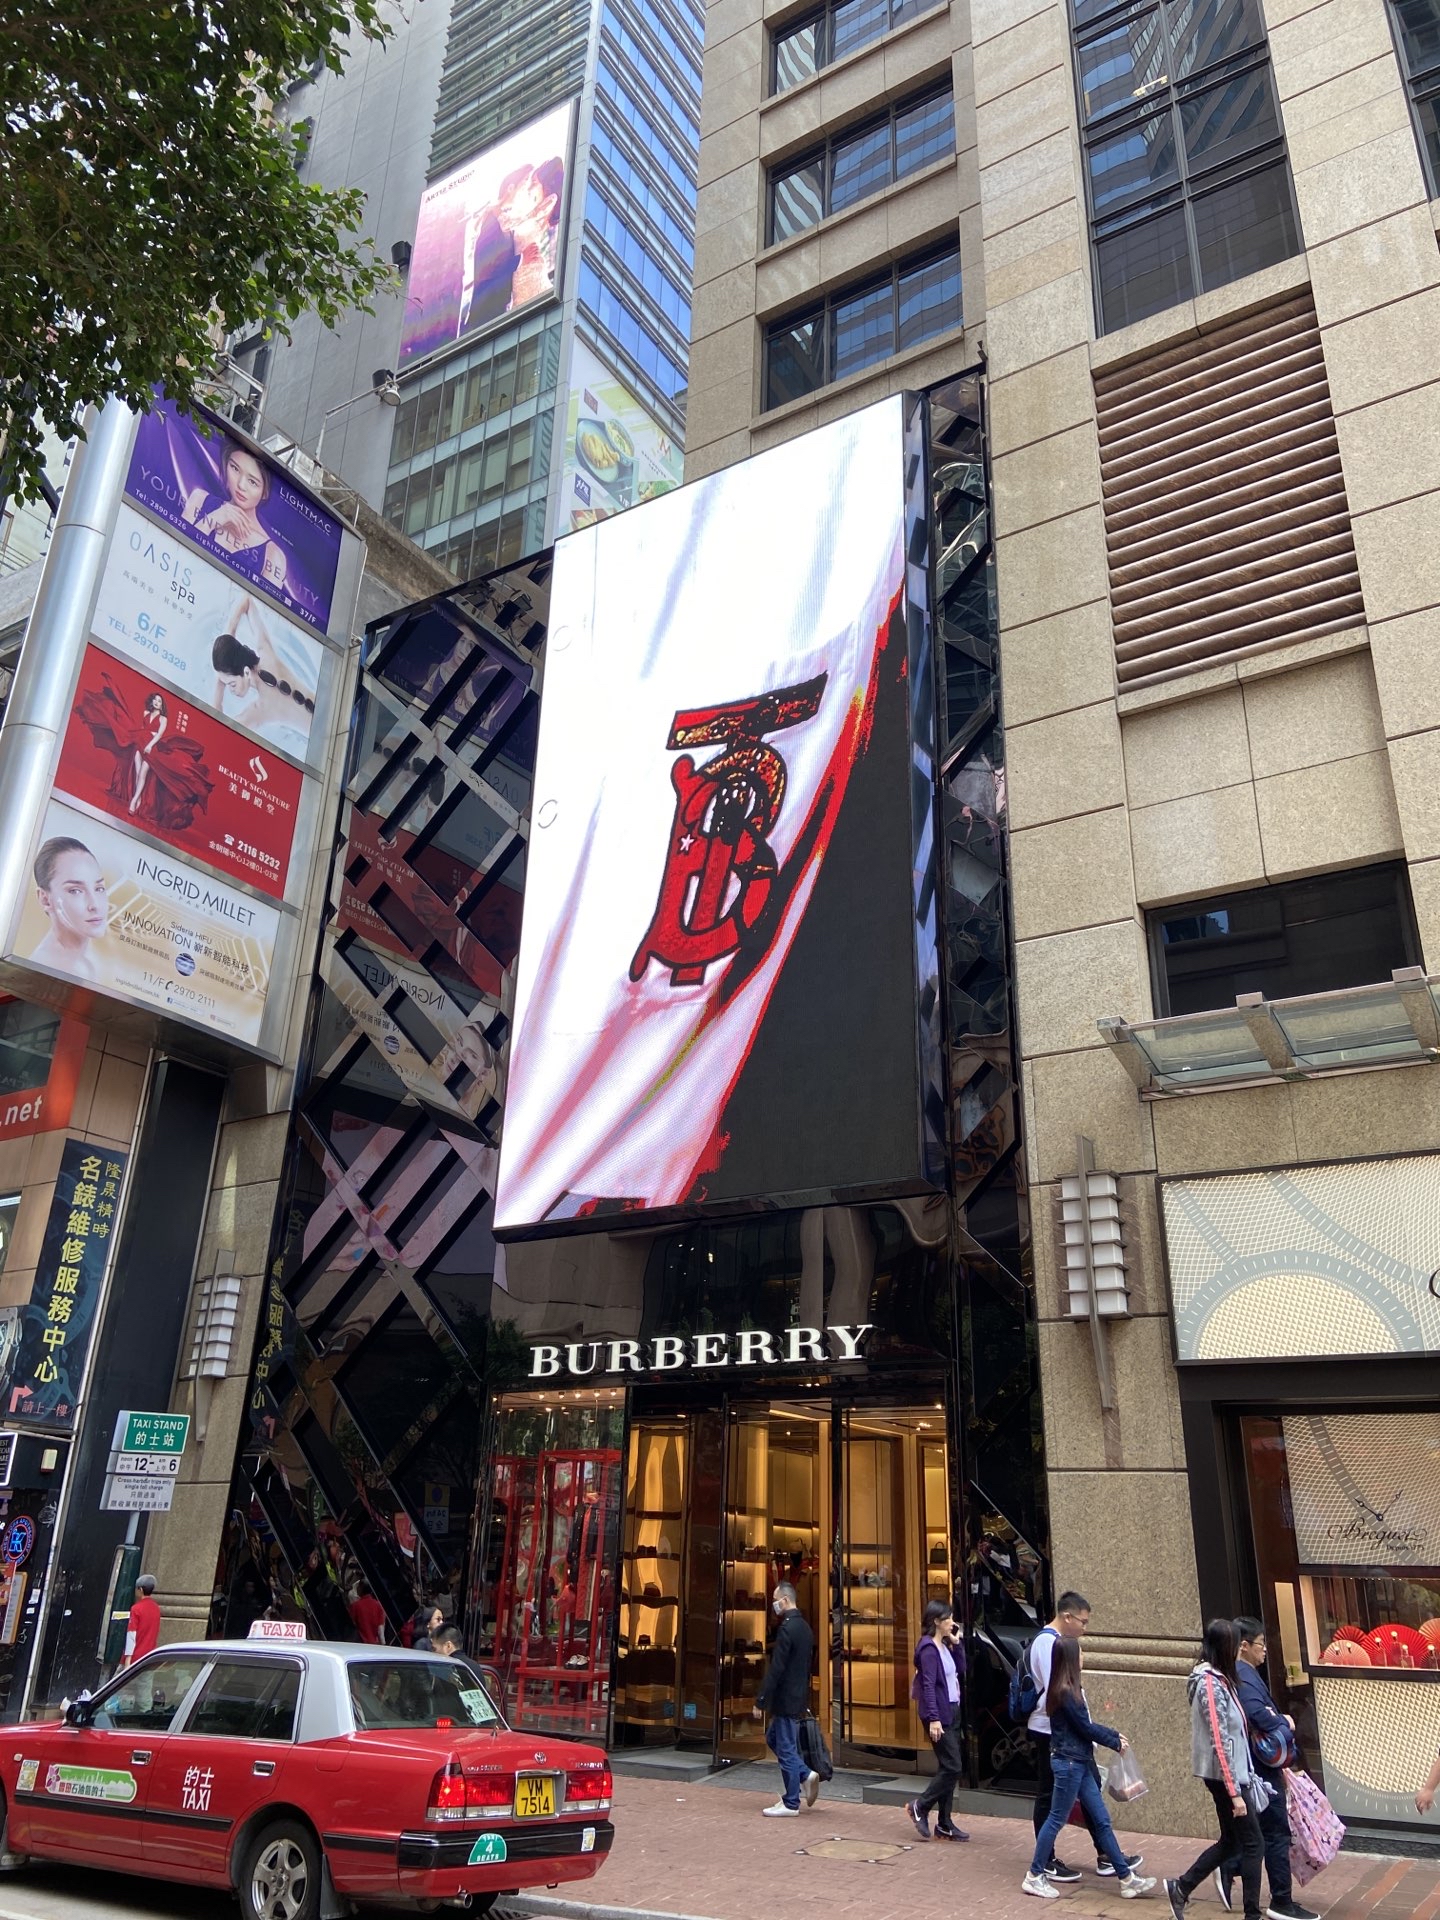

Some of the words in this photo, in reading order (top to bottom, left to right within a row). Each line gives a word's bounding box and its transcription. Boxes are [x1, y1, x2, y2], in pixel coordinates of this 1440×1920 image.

[135, 488, 149, 503] Tel:
[150, 500, 168, 516] 2890
[169, 513, 187, 530] 6326
[141, 465, 187, 508] YOUR
[193, 507, 259, 563] ENDLESS
[130, 531, 193, 587] OASIS
[195, 533, 246, 573] LightMAC.com
[170, 580, 196, 605] spa
[137, 612, 167, 639] 6/F
[300, 607, 316, 623] 37/F
[108, 615, 131, 637] TEL:
[133, 632, 159, 654] 2970
[162, 649, 187, 671] 3328
[218, 764, 250, 787] BEAUTY
[250, 781, 291, 812] SIGNATURE
[237, 840, 257, 859] 2116
[259, 851, 281, 871] 5232
[136, 858, 200, 900] INGRID
[201, 890, 257, 927] MILLET
[123, 911, 192, 950] INNOVATION
[142, 971, 165, 988] 11/F
[173, 983, 196, 1000] 2970
[197, 994, 216, 1009] 2111
[92, 1160, 123, 1239] 隆晟精時
[33, 1155, 102, 1384] 名錶維修服務中心
[528, 1324, 873, 1378] BURBERRY
[20, 1400, 69, 1419] 請上一樓
[133, 1418, 151, 1429] TAXI
[153, 1420, 184, 1431] STAND
[134, 1431, 175, 1447] 的士站
[134, 1457, 148, 1471] 12
[169, 1459, 177, 1472] 6
[1327, 1517, 1428, 1551] Breguet
[262, 1622, 304, 1638] TAXI
[184, 1765, 215, 1789] 的士
[527, 1779, 544, 1797] VM
[181, 1787, 212, 1812] TAXI
[521, 1797, 550, 1815] 7514
[476, 1853, 500, 1862] SEATS
[485, 1841, 493, 1854] 4
